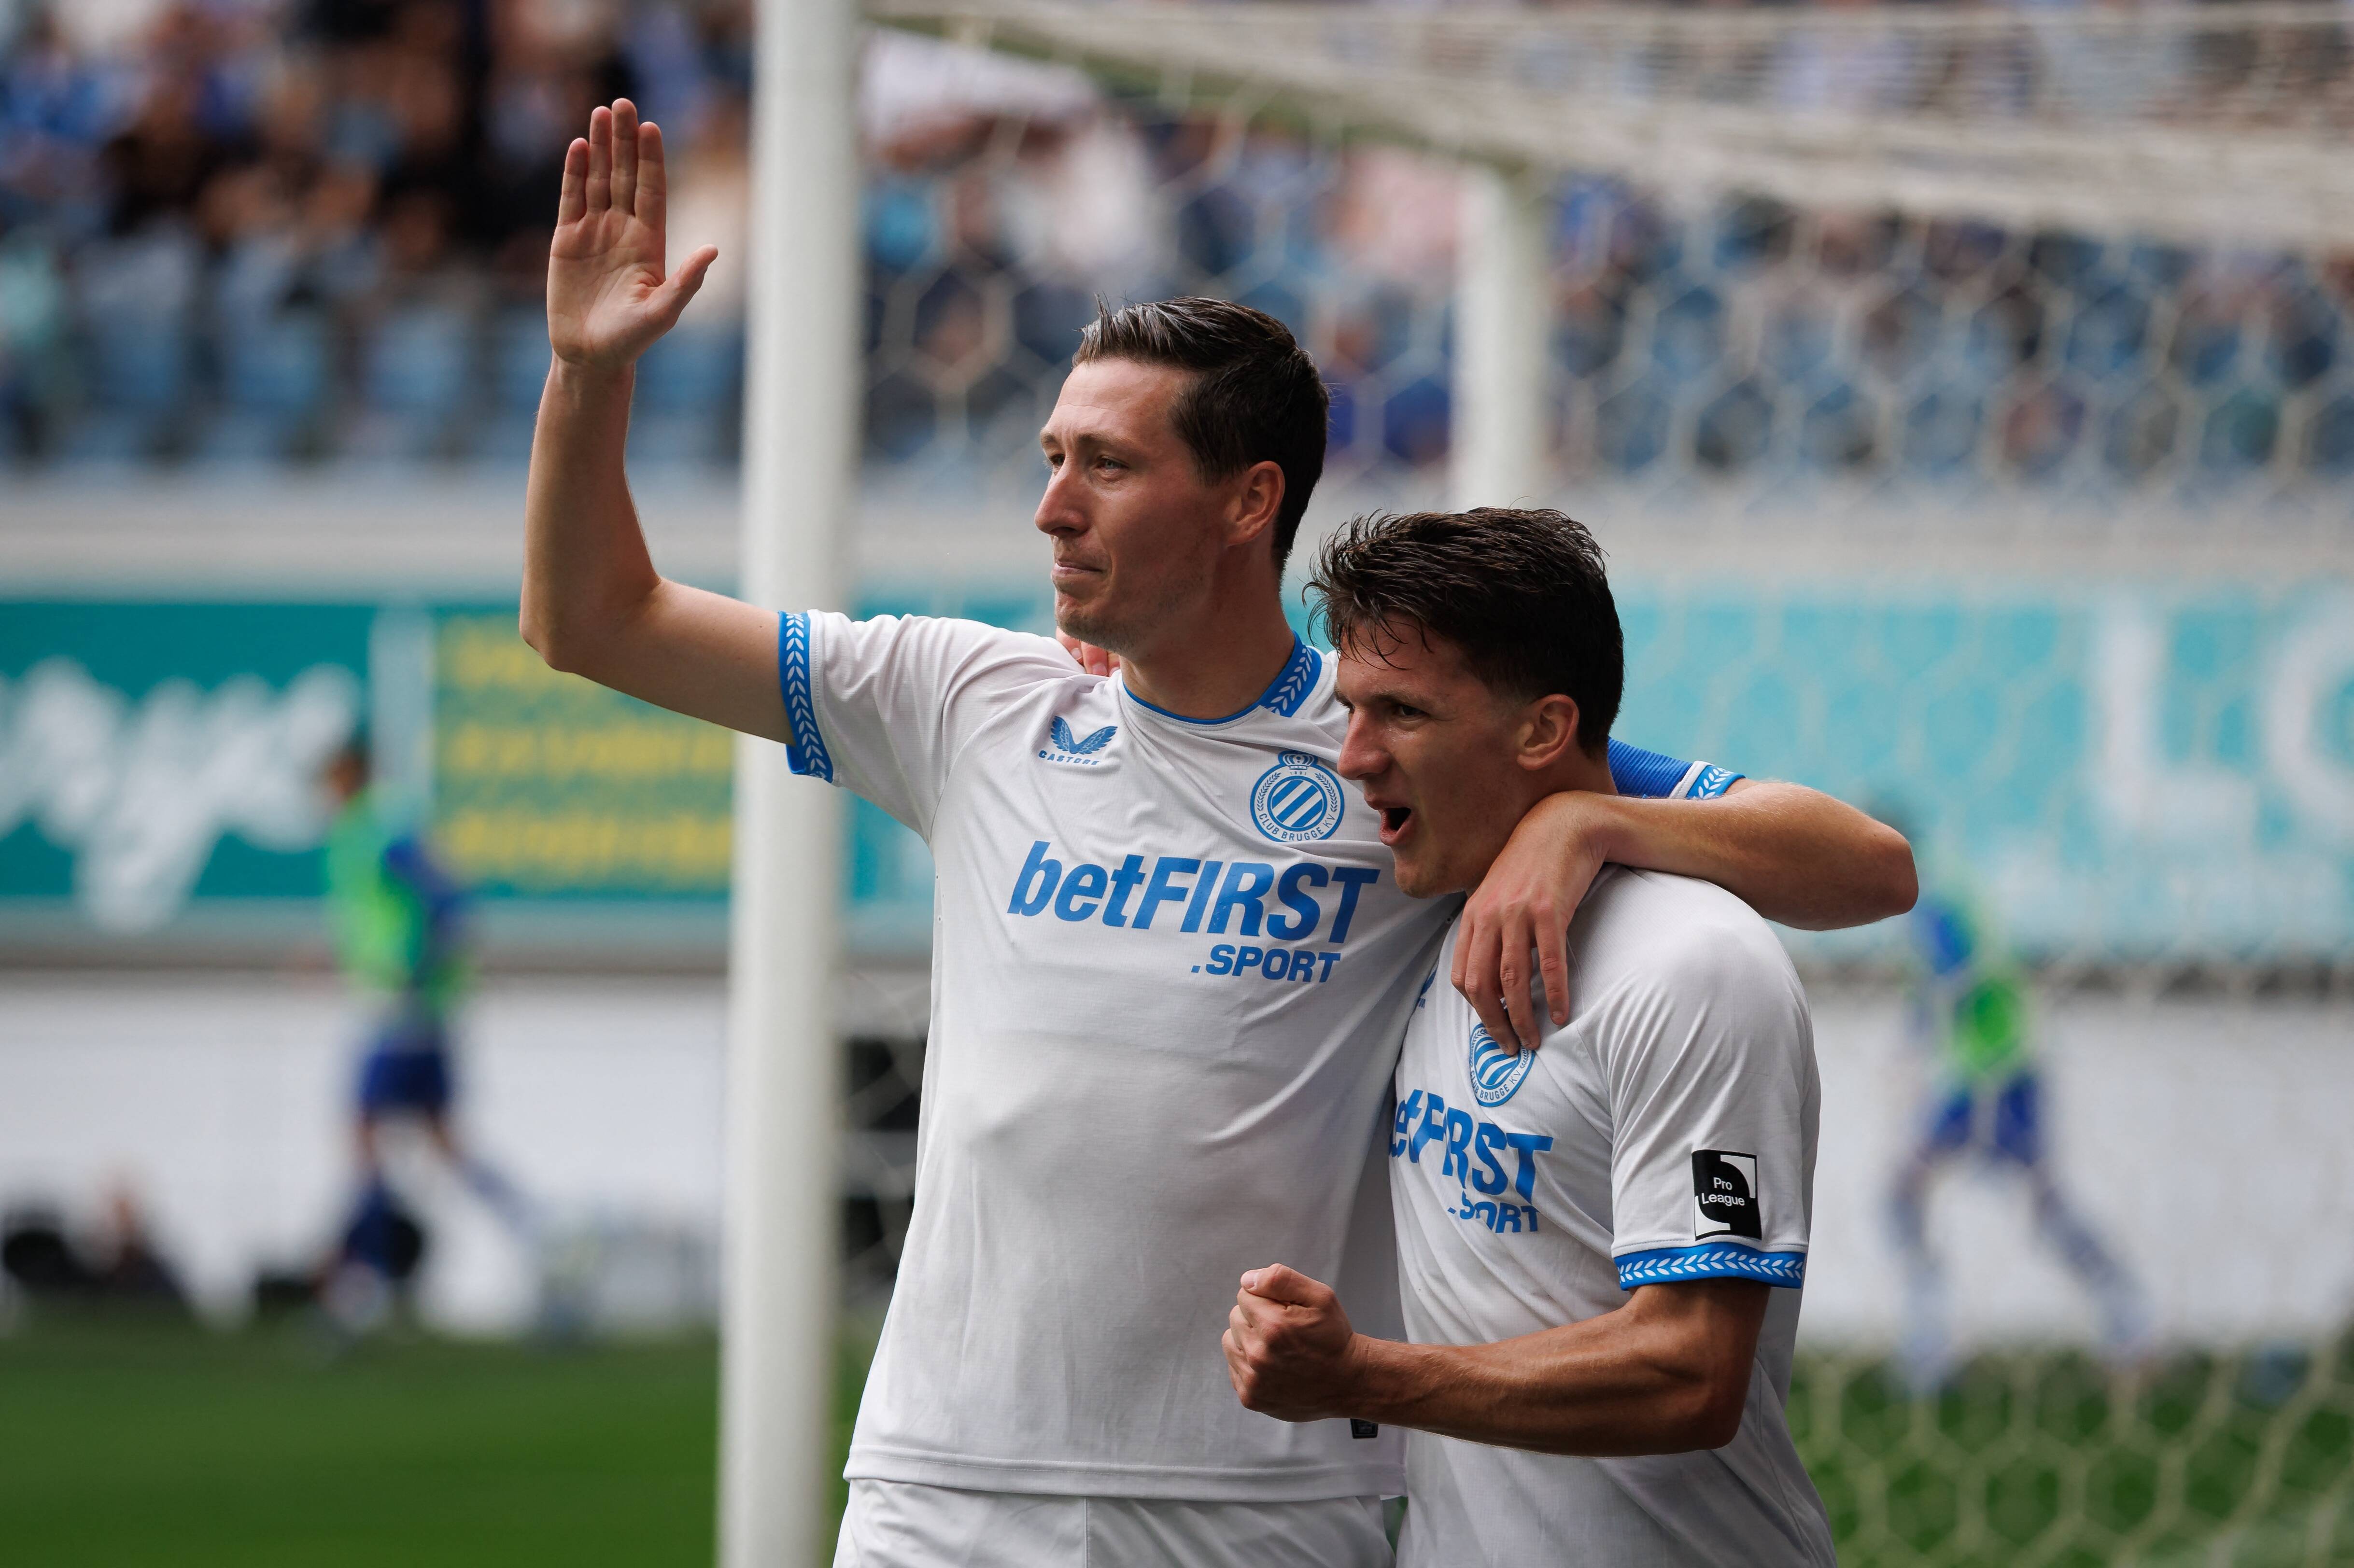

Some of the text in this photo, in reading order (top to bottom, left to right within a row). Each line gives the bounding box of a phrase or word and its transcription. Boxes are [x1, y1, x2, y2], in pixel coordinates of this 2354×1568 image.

[1039, 750, 1099, 765] CASTORE
[1259, 812, 1336, 841] CLUB BRUGGE KV
[1007, 840, 1381, 944] betFIRST
[1191, 944, 1341, 983] .SPORT
[1480, 1083, 1510, 1101] BRUGGE
[1508, 1070, 1522, 1085] KV
[1713, 1176, 1733, 1190] Pro
[1701, 1192, 1746, 1206] League
